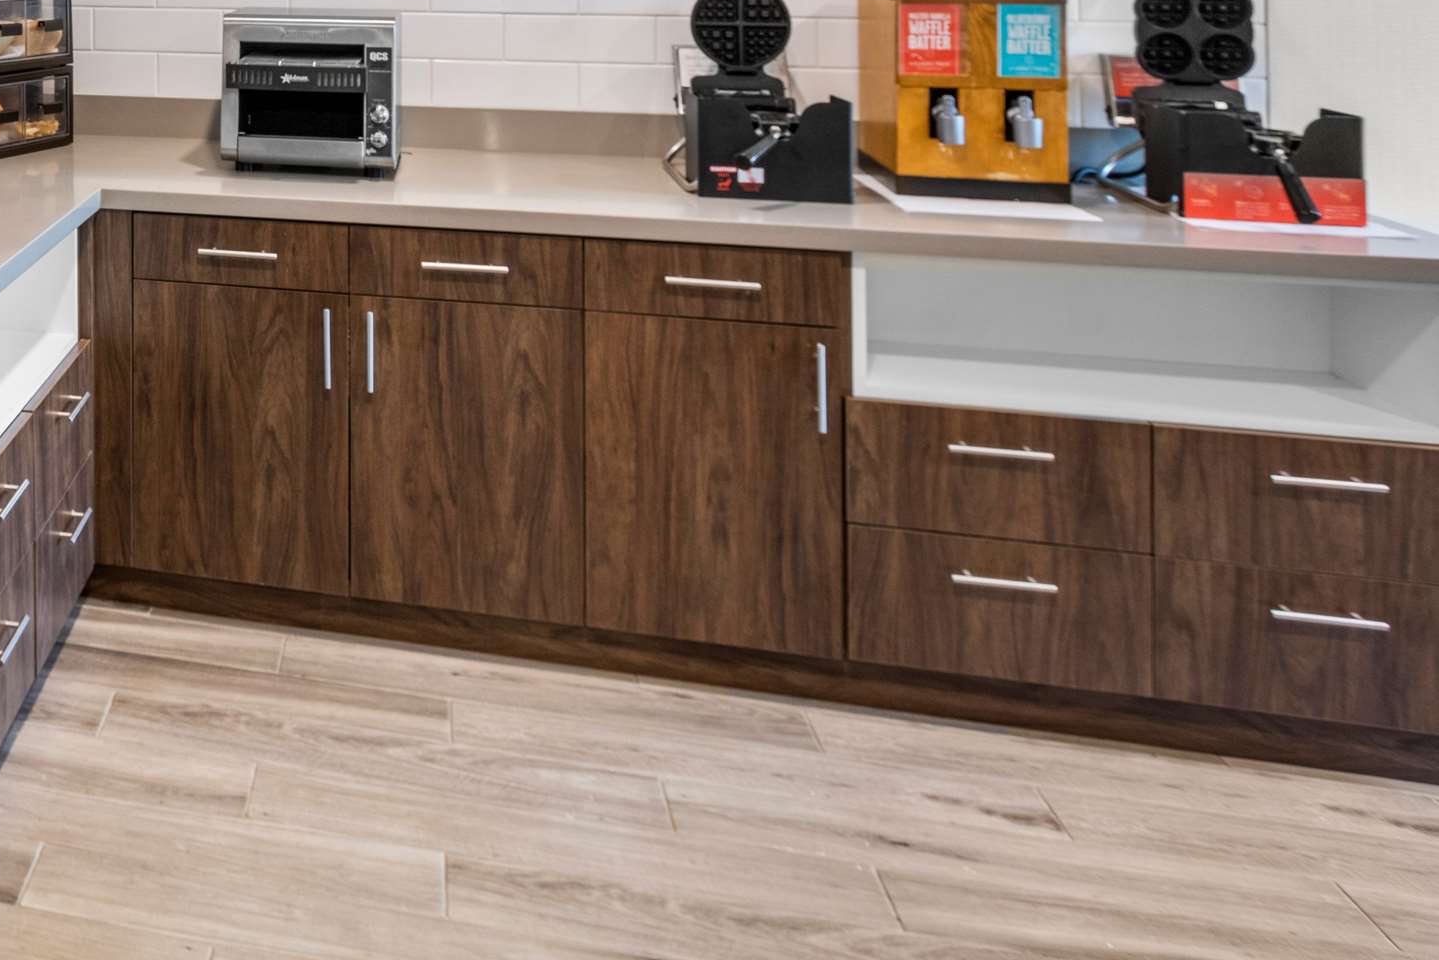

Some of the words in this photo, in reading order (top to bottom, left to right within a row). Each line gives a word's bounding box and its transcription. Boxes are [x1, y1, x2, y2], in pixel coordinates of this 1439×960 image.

[908, 20, 951, 35] WAFFLE
[908, 34, 951, 50] BATTER
[370, 51, 388, 63] QCS
